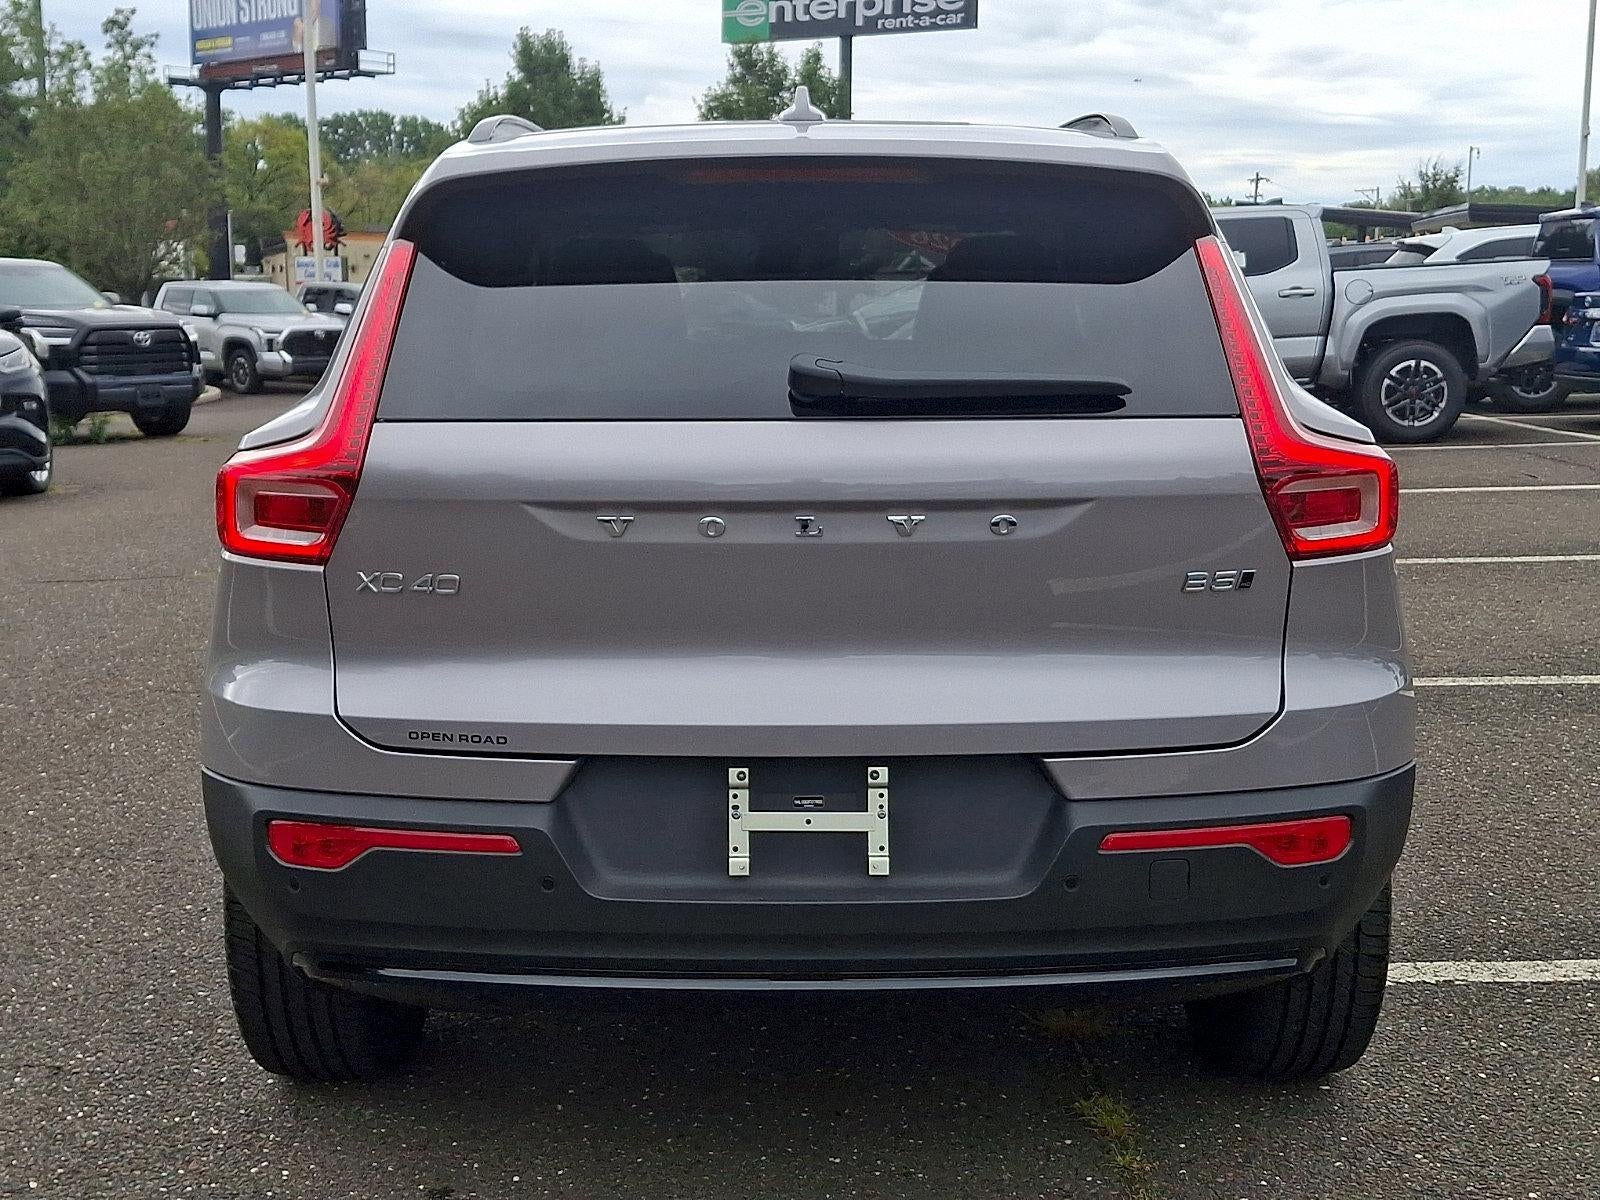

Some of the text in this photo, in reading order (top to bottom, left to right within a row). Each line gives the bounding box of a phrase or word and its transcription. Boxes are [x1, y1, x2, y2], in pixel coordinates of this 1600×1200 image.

[192, 0, 238, 30] UNION
[724, 0, 966, 27] enterprise
[876, 11, 965, 30] rent-a-car
[596, 515, 1019, 538] VOLVO
[408, 731, 508, 745] OPEN ROAD
